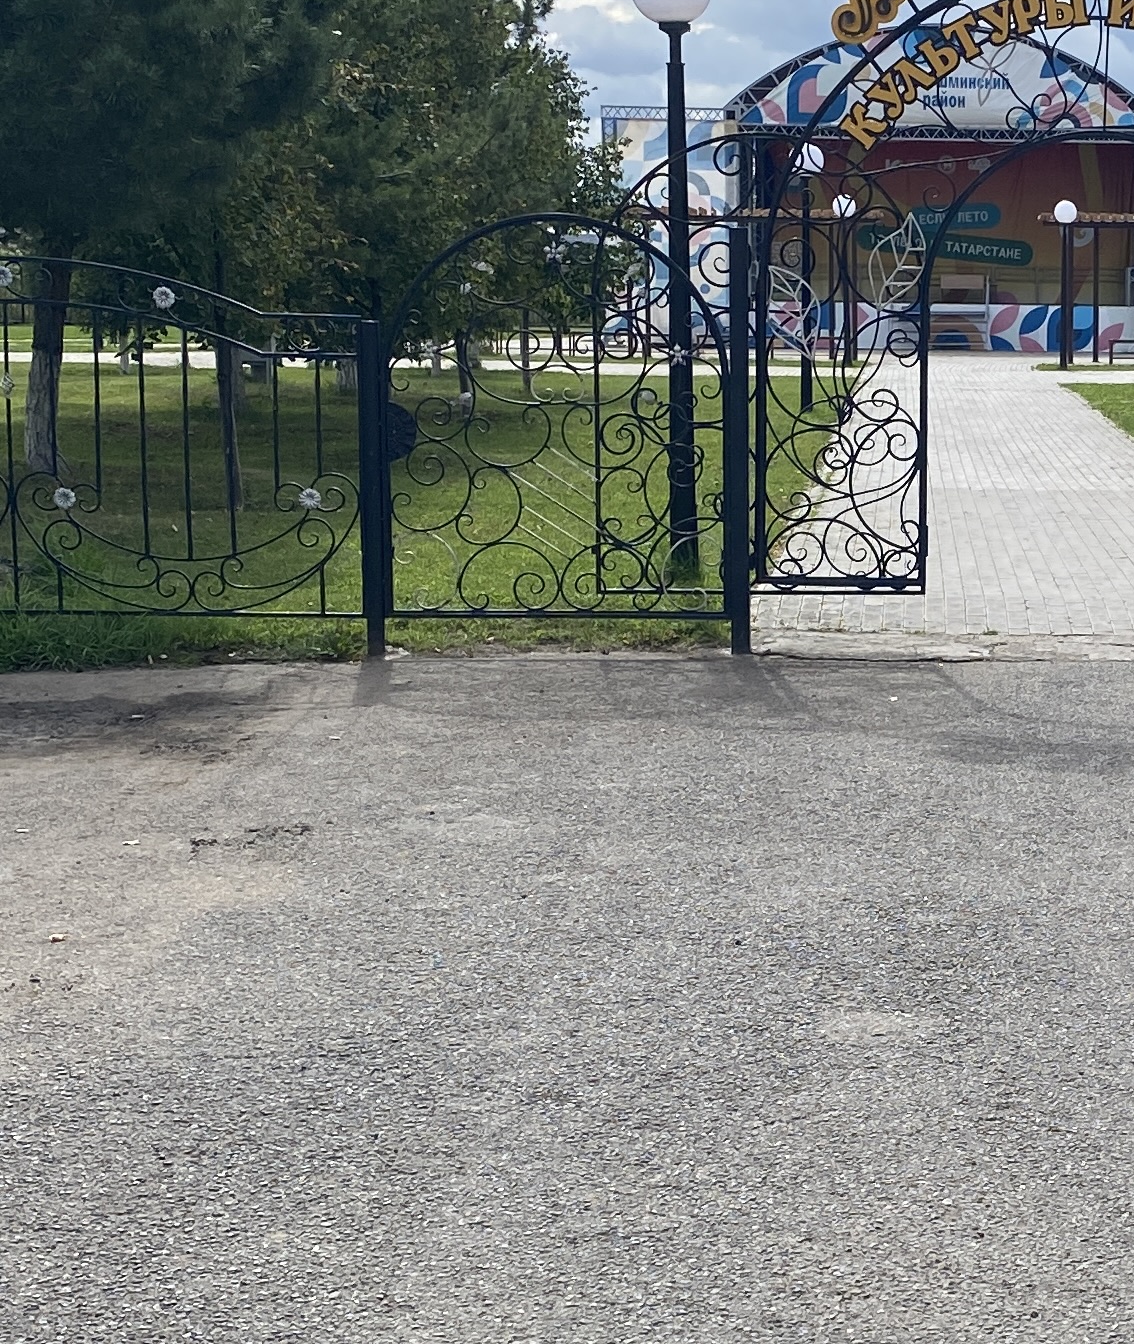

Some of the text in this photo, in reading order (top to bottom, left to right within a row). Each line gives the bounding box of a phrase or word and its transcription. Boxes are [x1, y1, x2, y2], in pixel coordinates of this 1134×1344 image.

[938, 72, 1010, 90] шминский
[922, 90, 966, 110] район
[957, 211, 989, 223] ЛЕТО
[945, 241, 1022, 260] ТАТАРСТАНЕ
